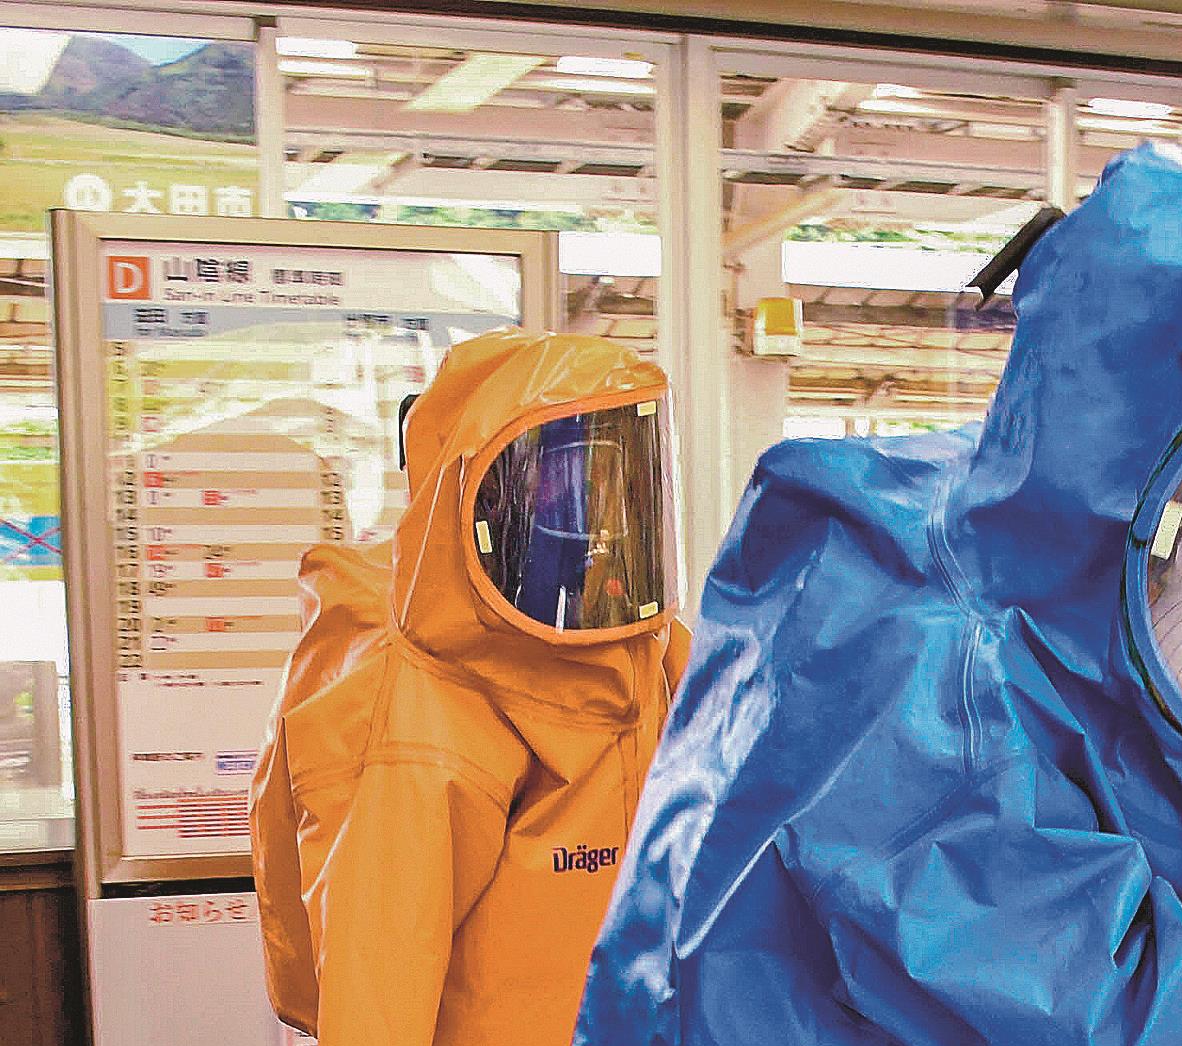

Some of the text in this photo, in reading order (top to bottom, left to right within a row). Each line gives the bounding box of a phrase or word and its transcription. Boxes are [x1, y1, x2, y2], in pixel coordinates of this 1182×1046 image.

[121, 180, 255, 217] 大田市
[551, 844, 620, 874] Dräger
[148, 900, 250, 924] お知らせ
